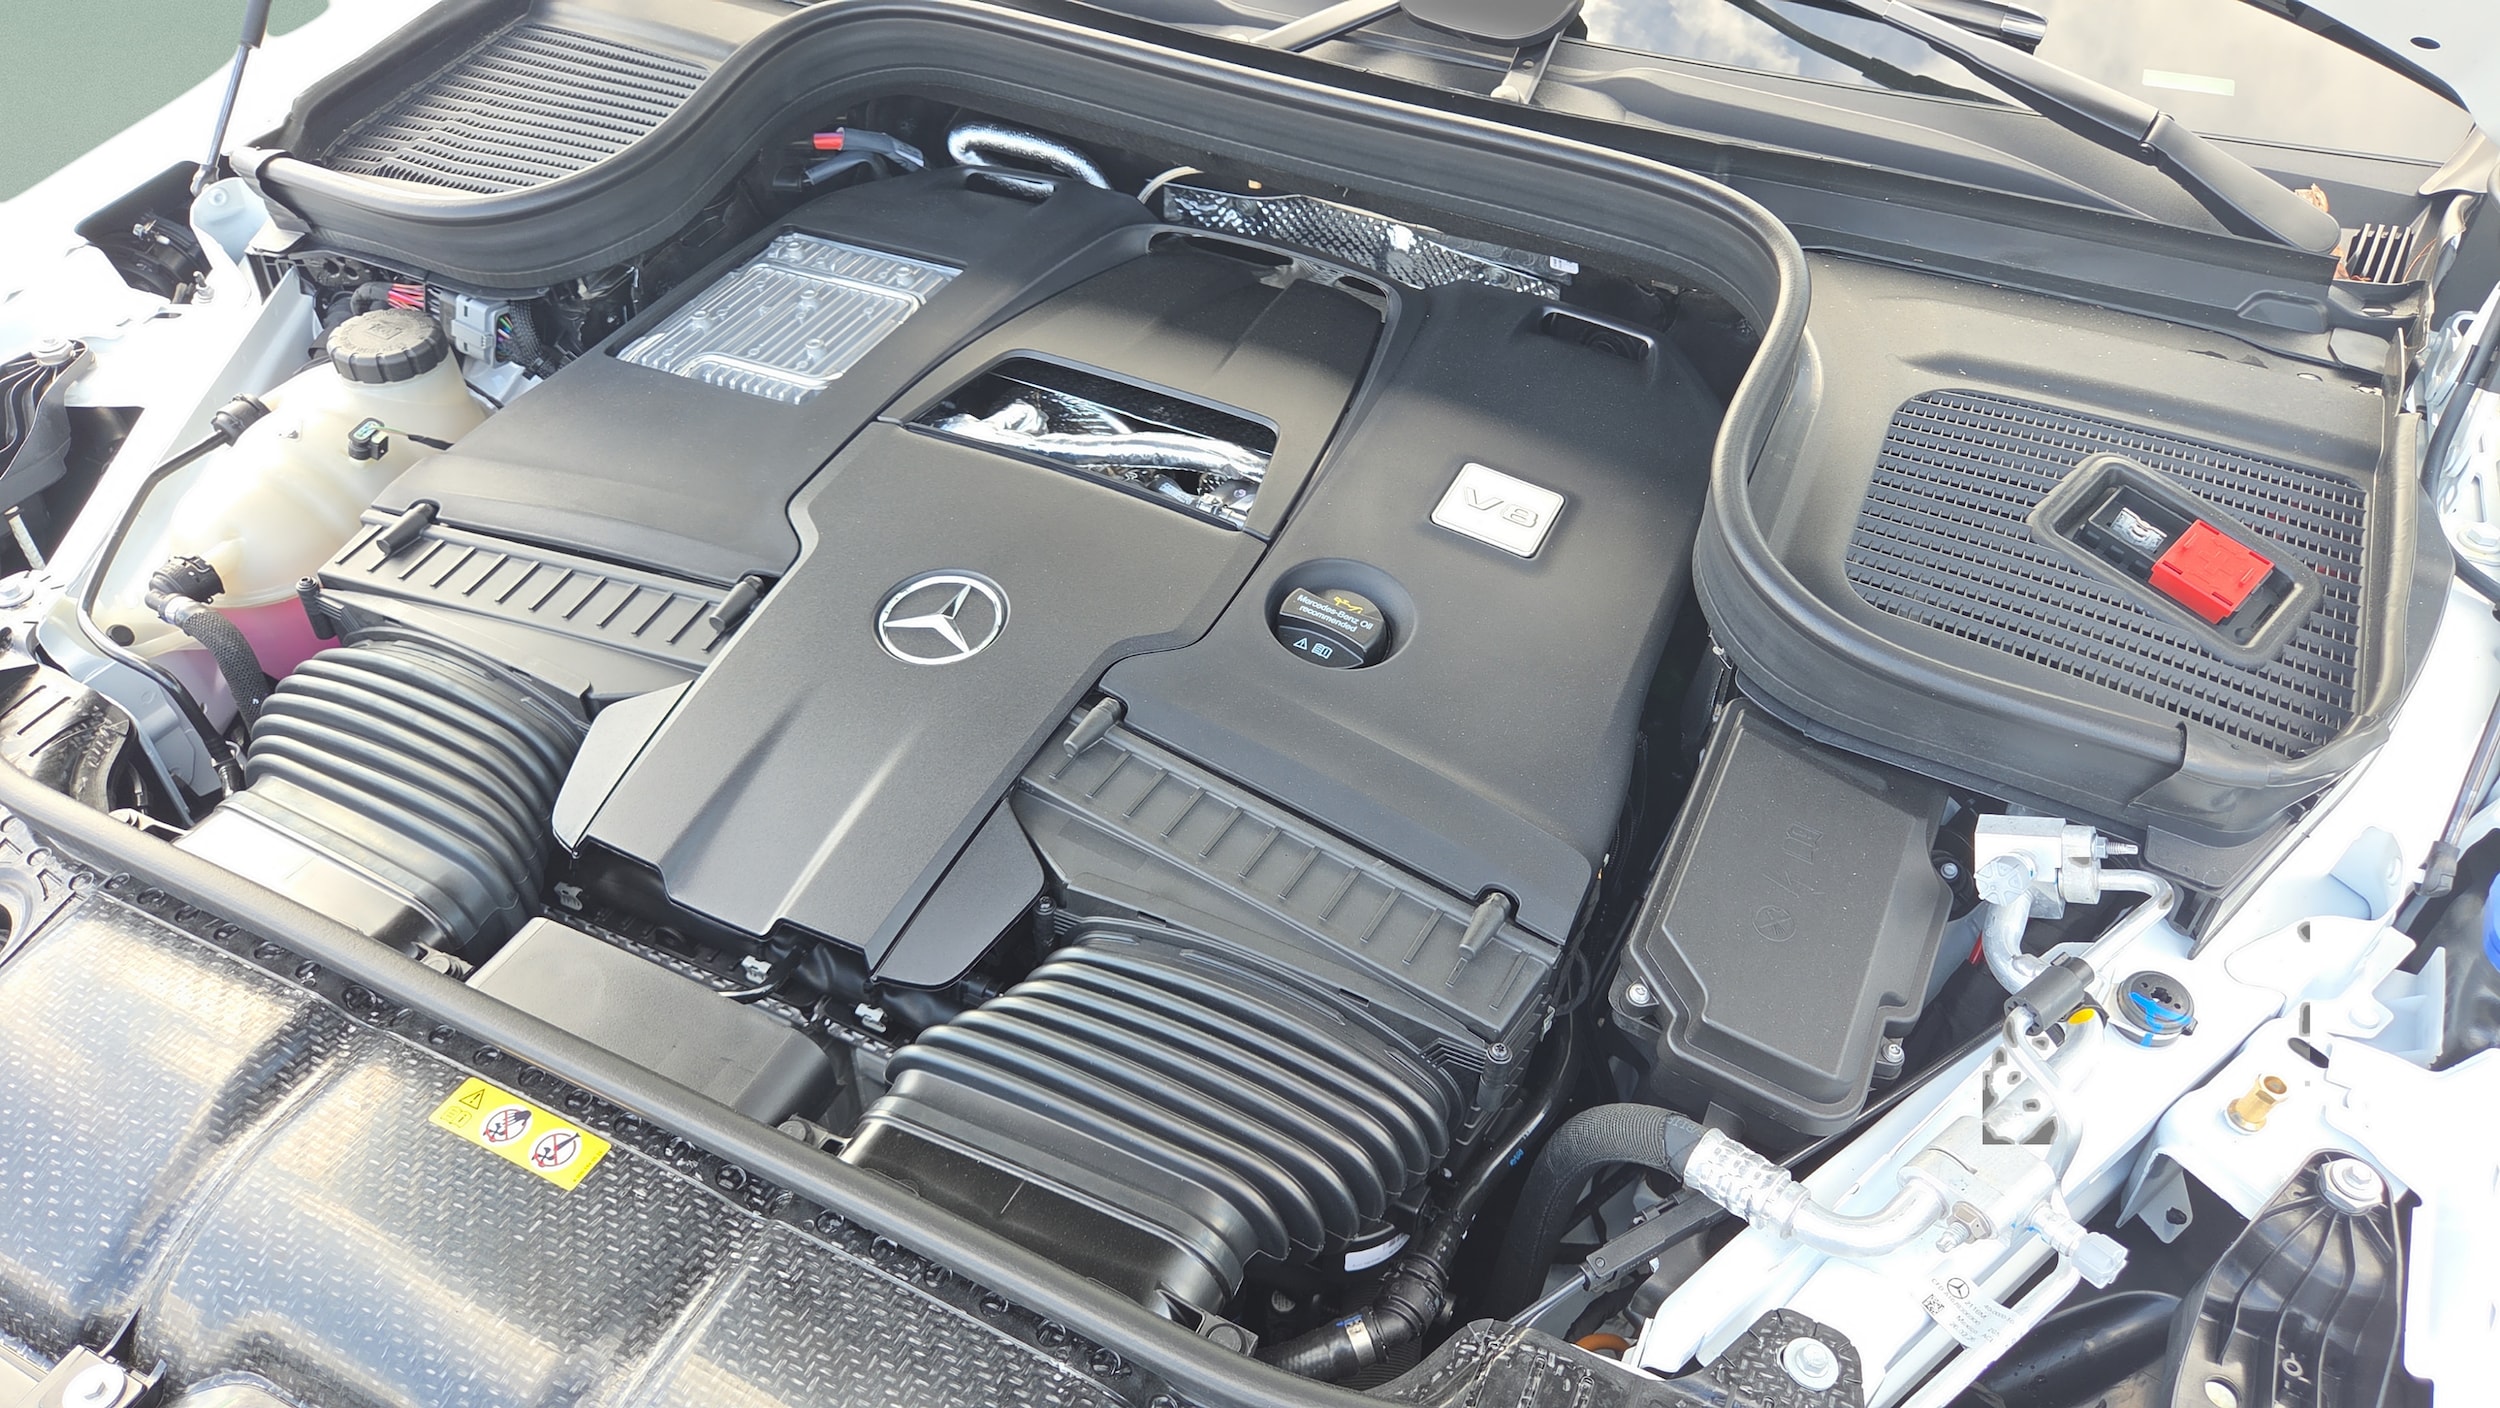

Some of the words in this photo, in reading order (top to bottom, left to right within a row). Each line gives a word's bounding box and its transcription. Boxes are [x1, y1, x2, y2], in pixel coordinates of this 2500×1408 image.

[1464, 486, 1539, 528] V8
[1296, 594, 1360, 625] Mercedes-Benz
[1360, 619, 1374, 631] Oil
[1299, 605, 1358, 633] recommended
